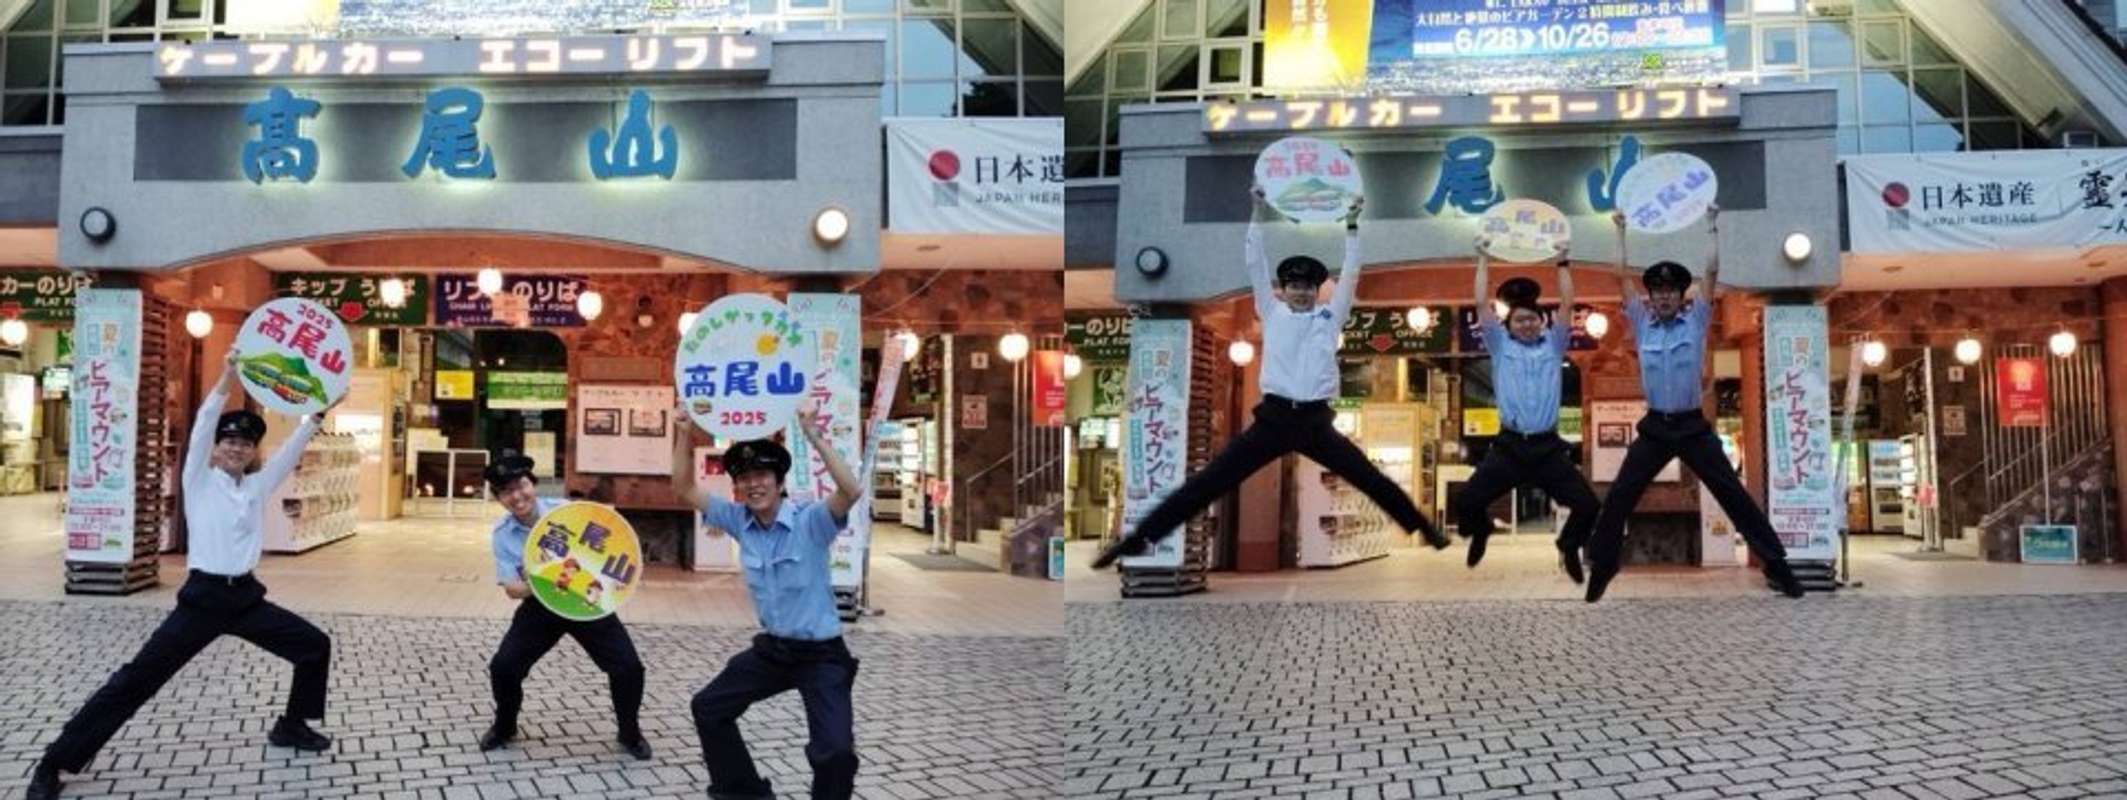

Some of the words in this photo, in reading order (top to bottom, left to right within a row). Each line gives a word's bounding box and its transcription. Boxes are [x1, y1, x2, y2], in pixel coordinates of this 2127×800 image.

[1922, 180, 2036, 211] 日本遺産
[1970, 213, 2038, 225] HERITAGE
[444, 281, 579, 301] リフのりば
[297, 303, 334, 329] 2025
[257, 307, 346, 376] 高尾山
[684, 360, 805, 398] 高尾山
[719, 411, 767, 425] 2025
[537, 520, 637, 585] 高尾山
